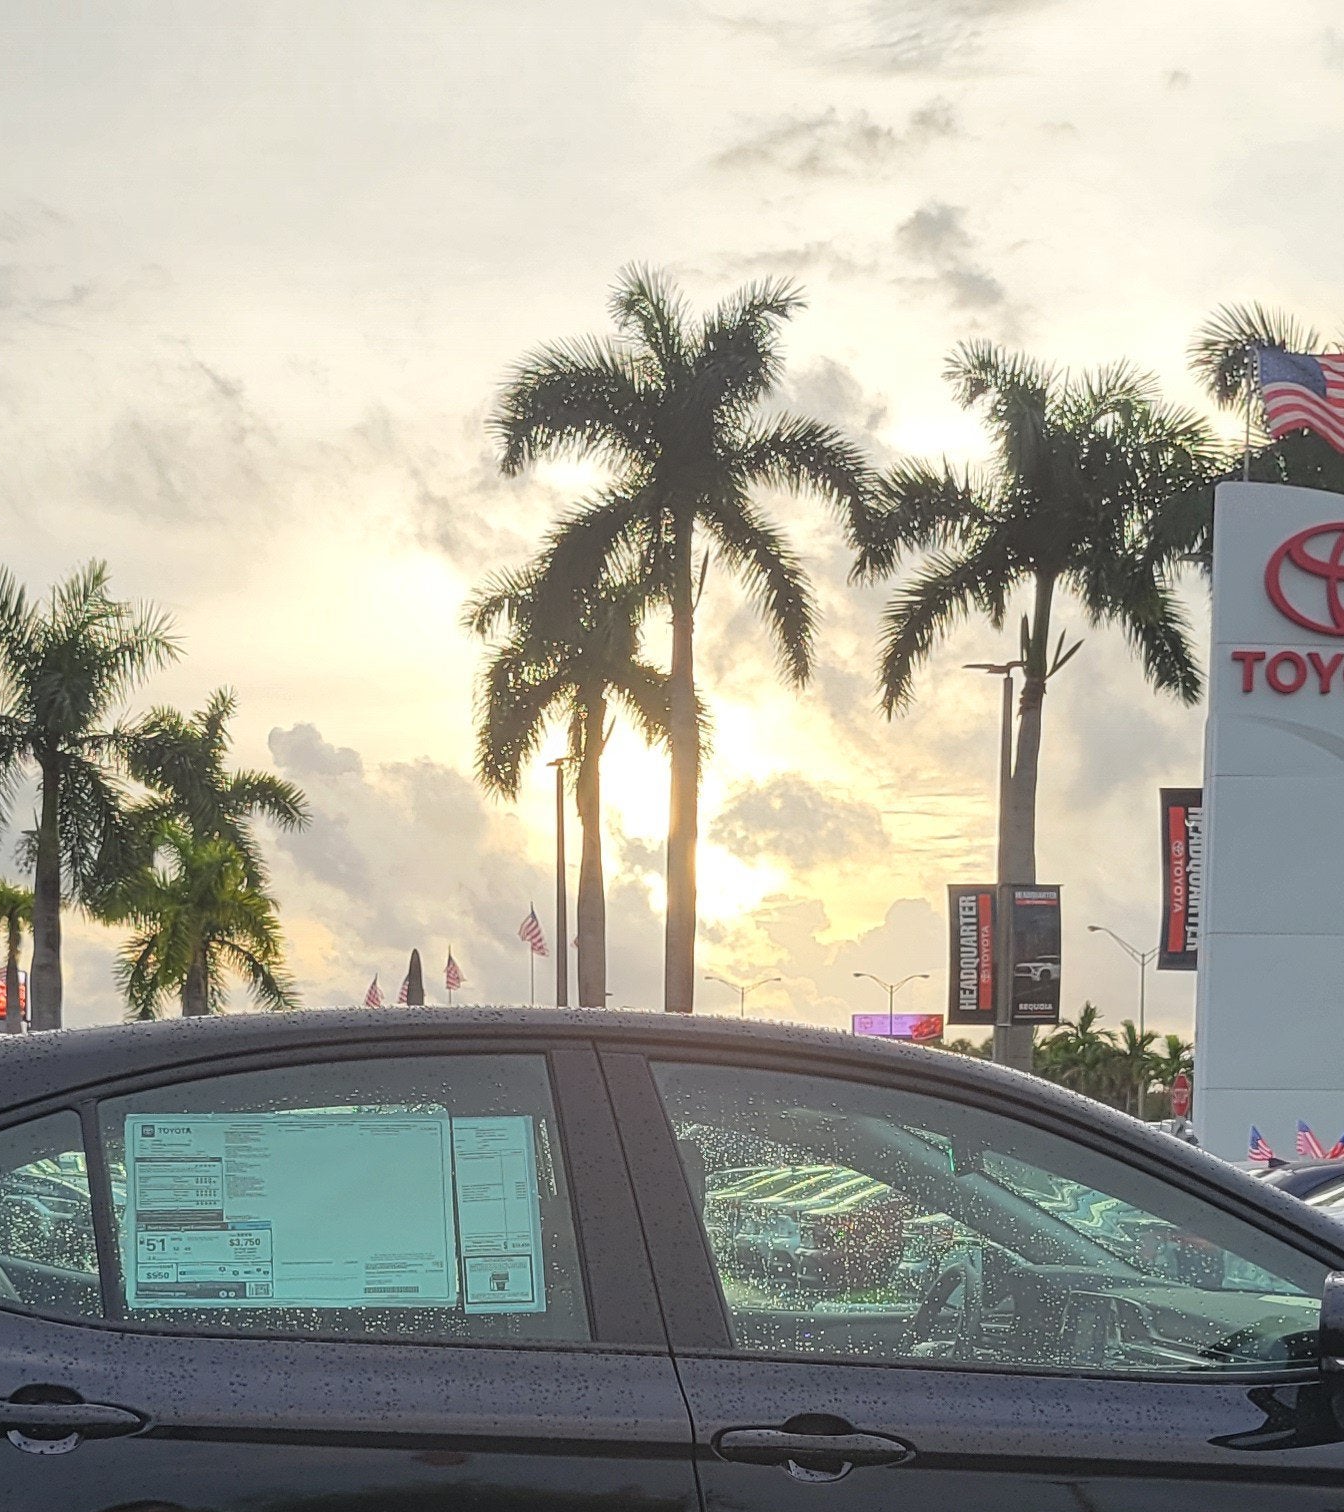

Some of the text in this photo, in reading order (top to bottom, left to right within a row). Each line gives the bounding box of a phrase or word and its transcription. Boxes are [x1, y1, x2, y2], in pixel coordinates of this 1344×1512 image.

[1172, 859, 1185, 913] TOYOTA
[959, 895, 980, 1010] HEADQUARTER
[980, 926, 991, 973] TOYOTA
[146, 1238, 166, 1252] 51
